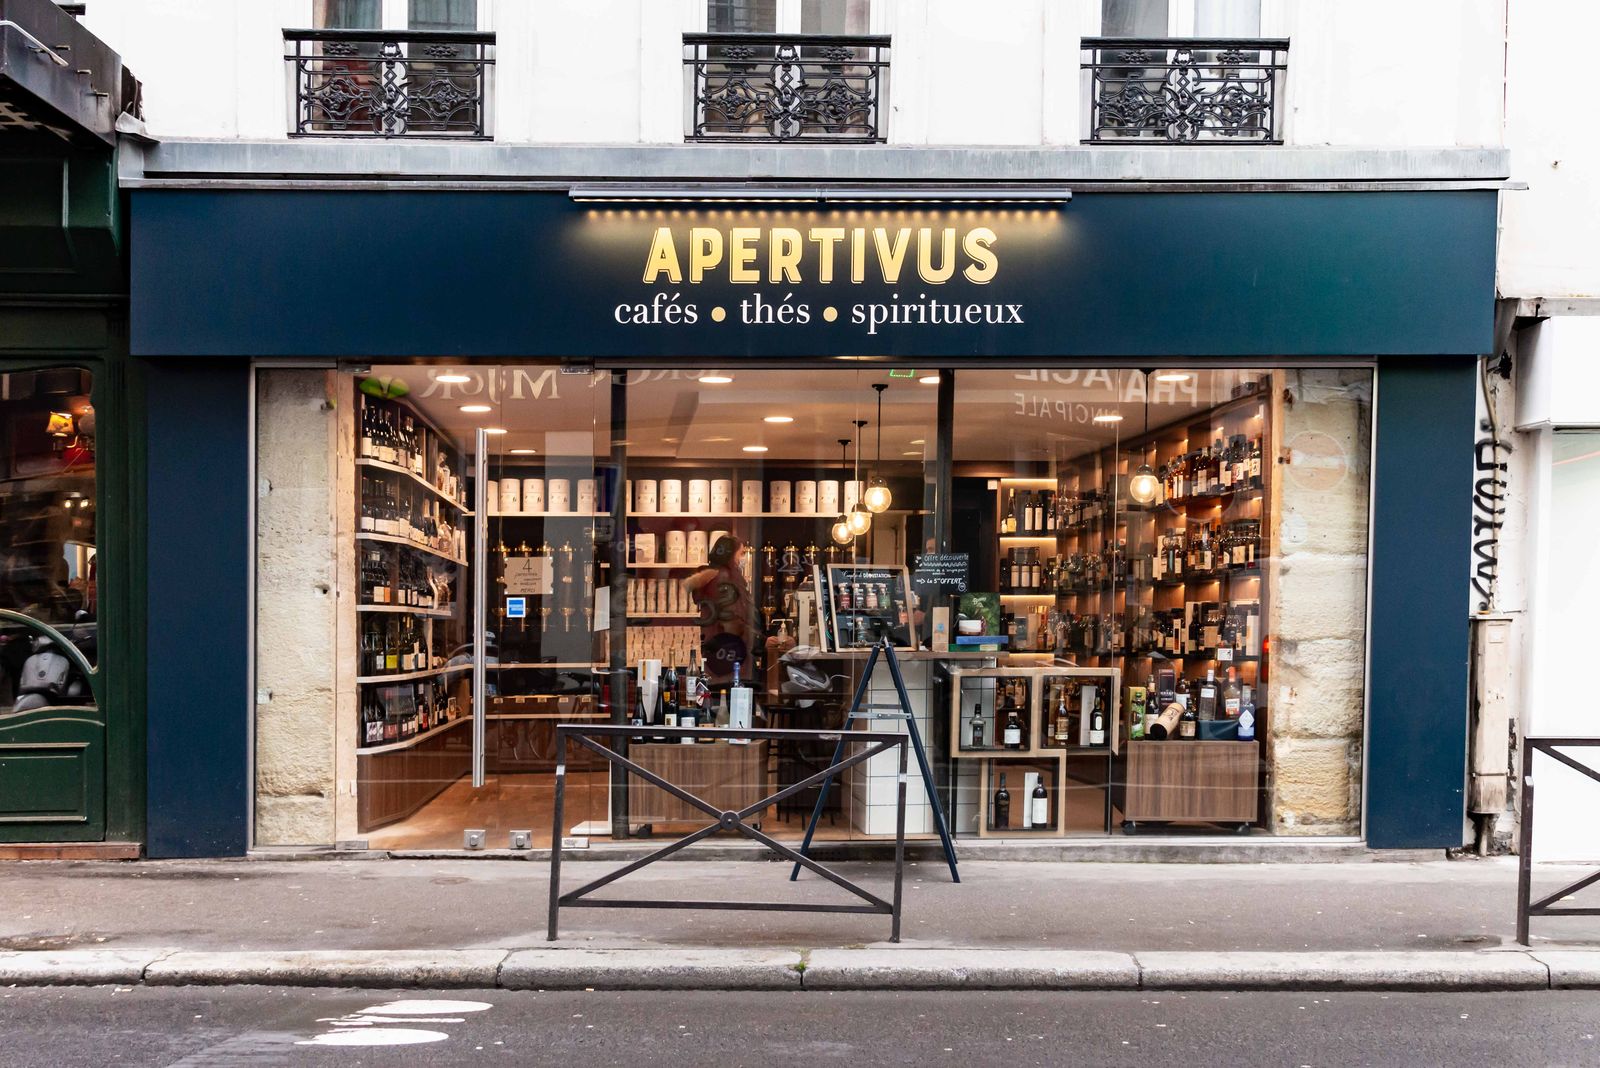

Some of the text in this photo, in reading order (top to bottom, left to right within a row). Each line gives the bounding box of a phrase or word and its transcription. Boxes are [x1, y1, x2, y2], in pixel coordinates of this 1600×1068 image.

[643, 227, 999, 285] APERTIVUS
[614, 292, 1024, 334] cafés thés spiritueux
[522, 559, 533, 573] 4
